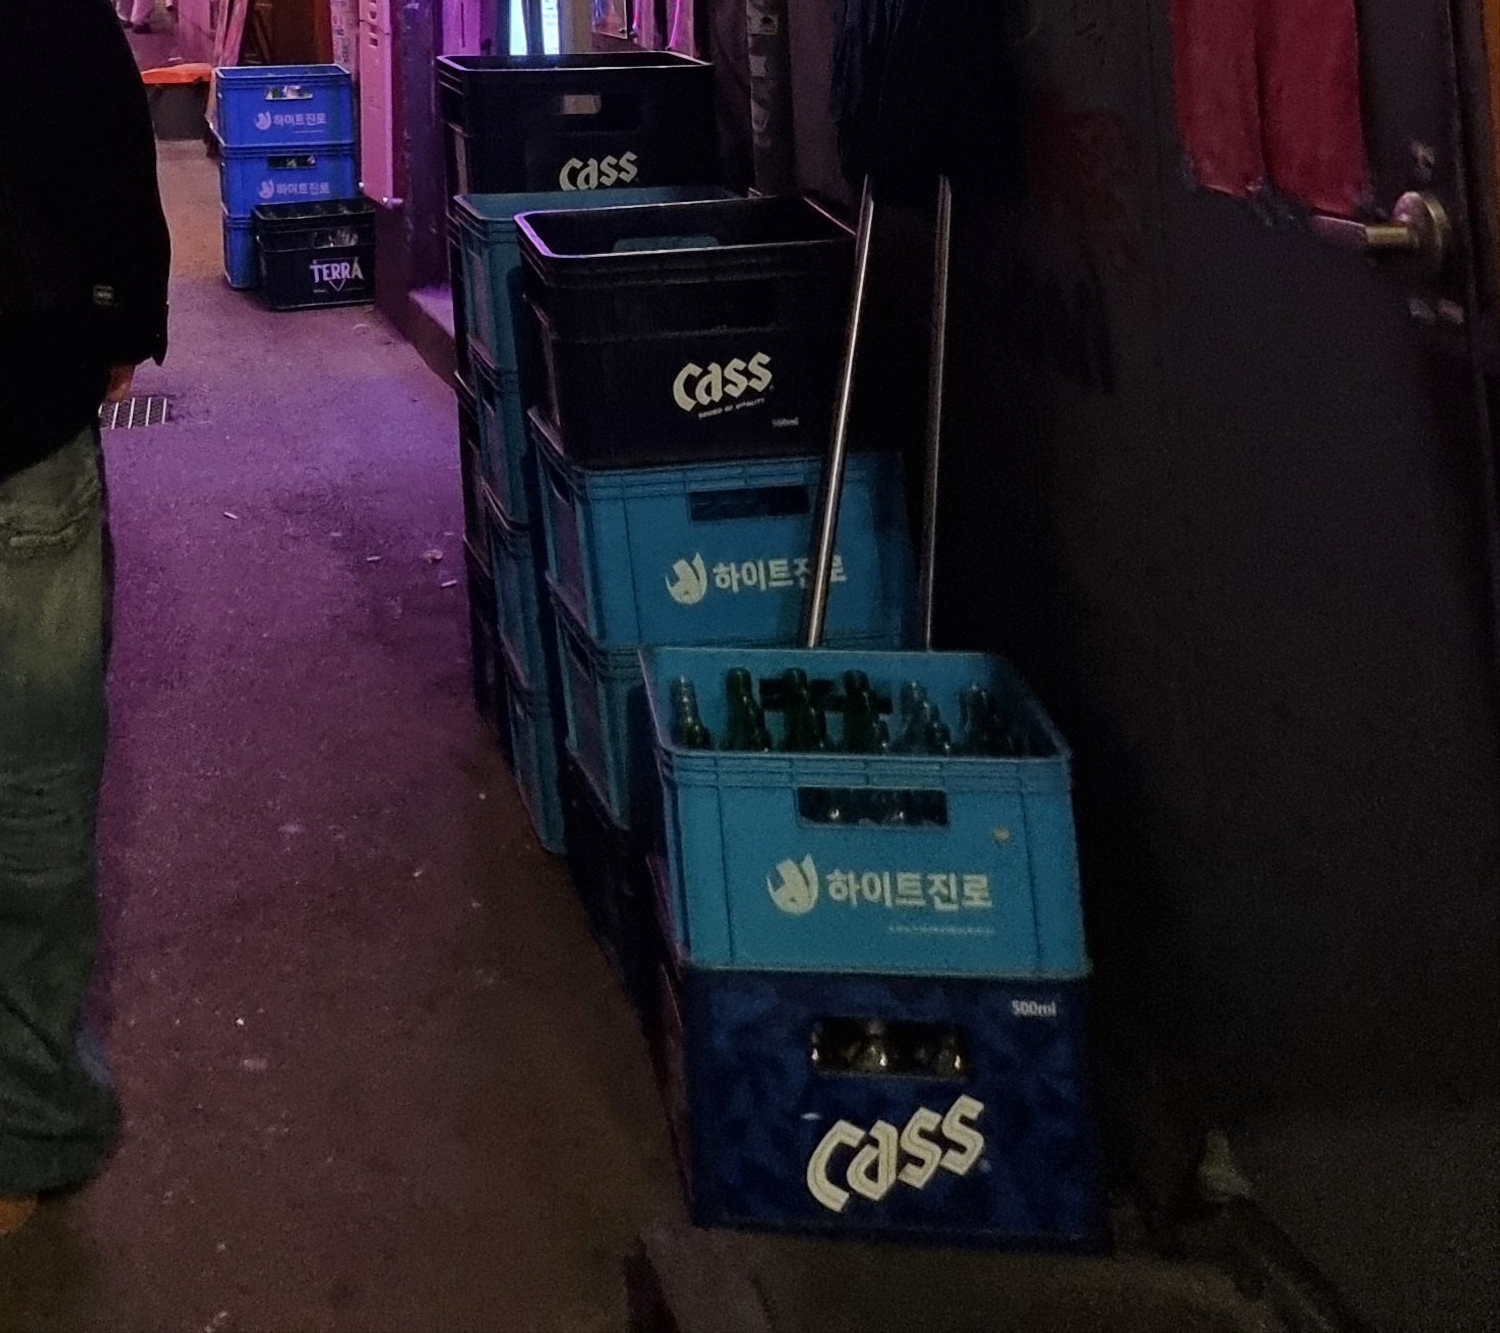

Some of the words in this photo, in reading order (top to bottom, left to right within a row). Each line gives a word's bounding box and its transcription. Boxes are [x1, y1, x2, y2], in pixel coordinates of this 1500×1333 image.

[273, 112, 327, 127] 하이트진로
[276, 181, 331, 196] 하이트진로
[559, 151, 638, 192] Cass
[310, 257, 365, 284] TERRA
[673, 351, 773, 412] Cass
[826, 868, 993, 912] 하이트진로
[1011, 999, 1057, 1017] 500ml
[806, 1093, 986, 1214] Cass
